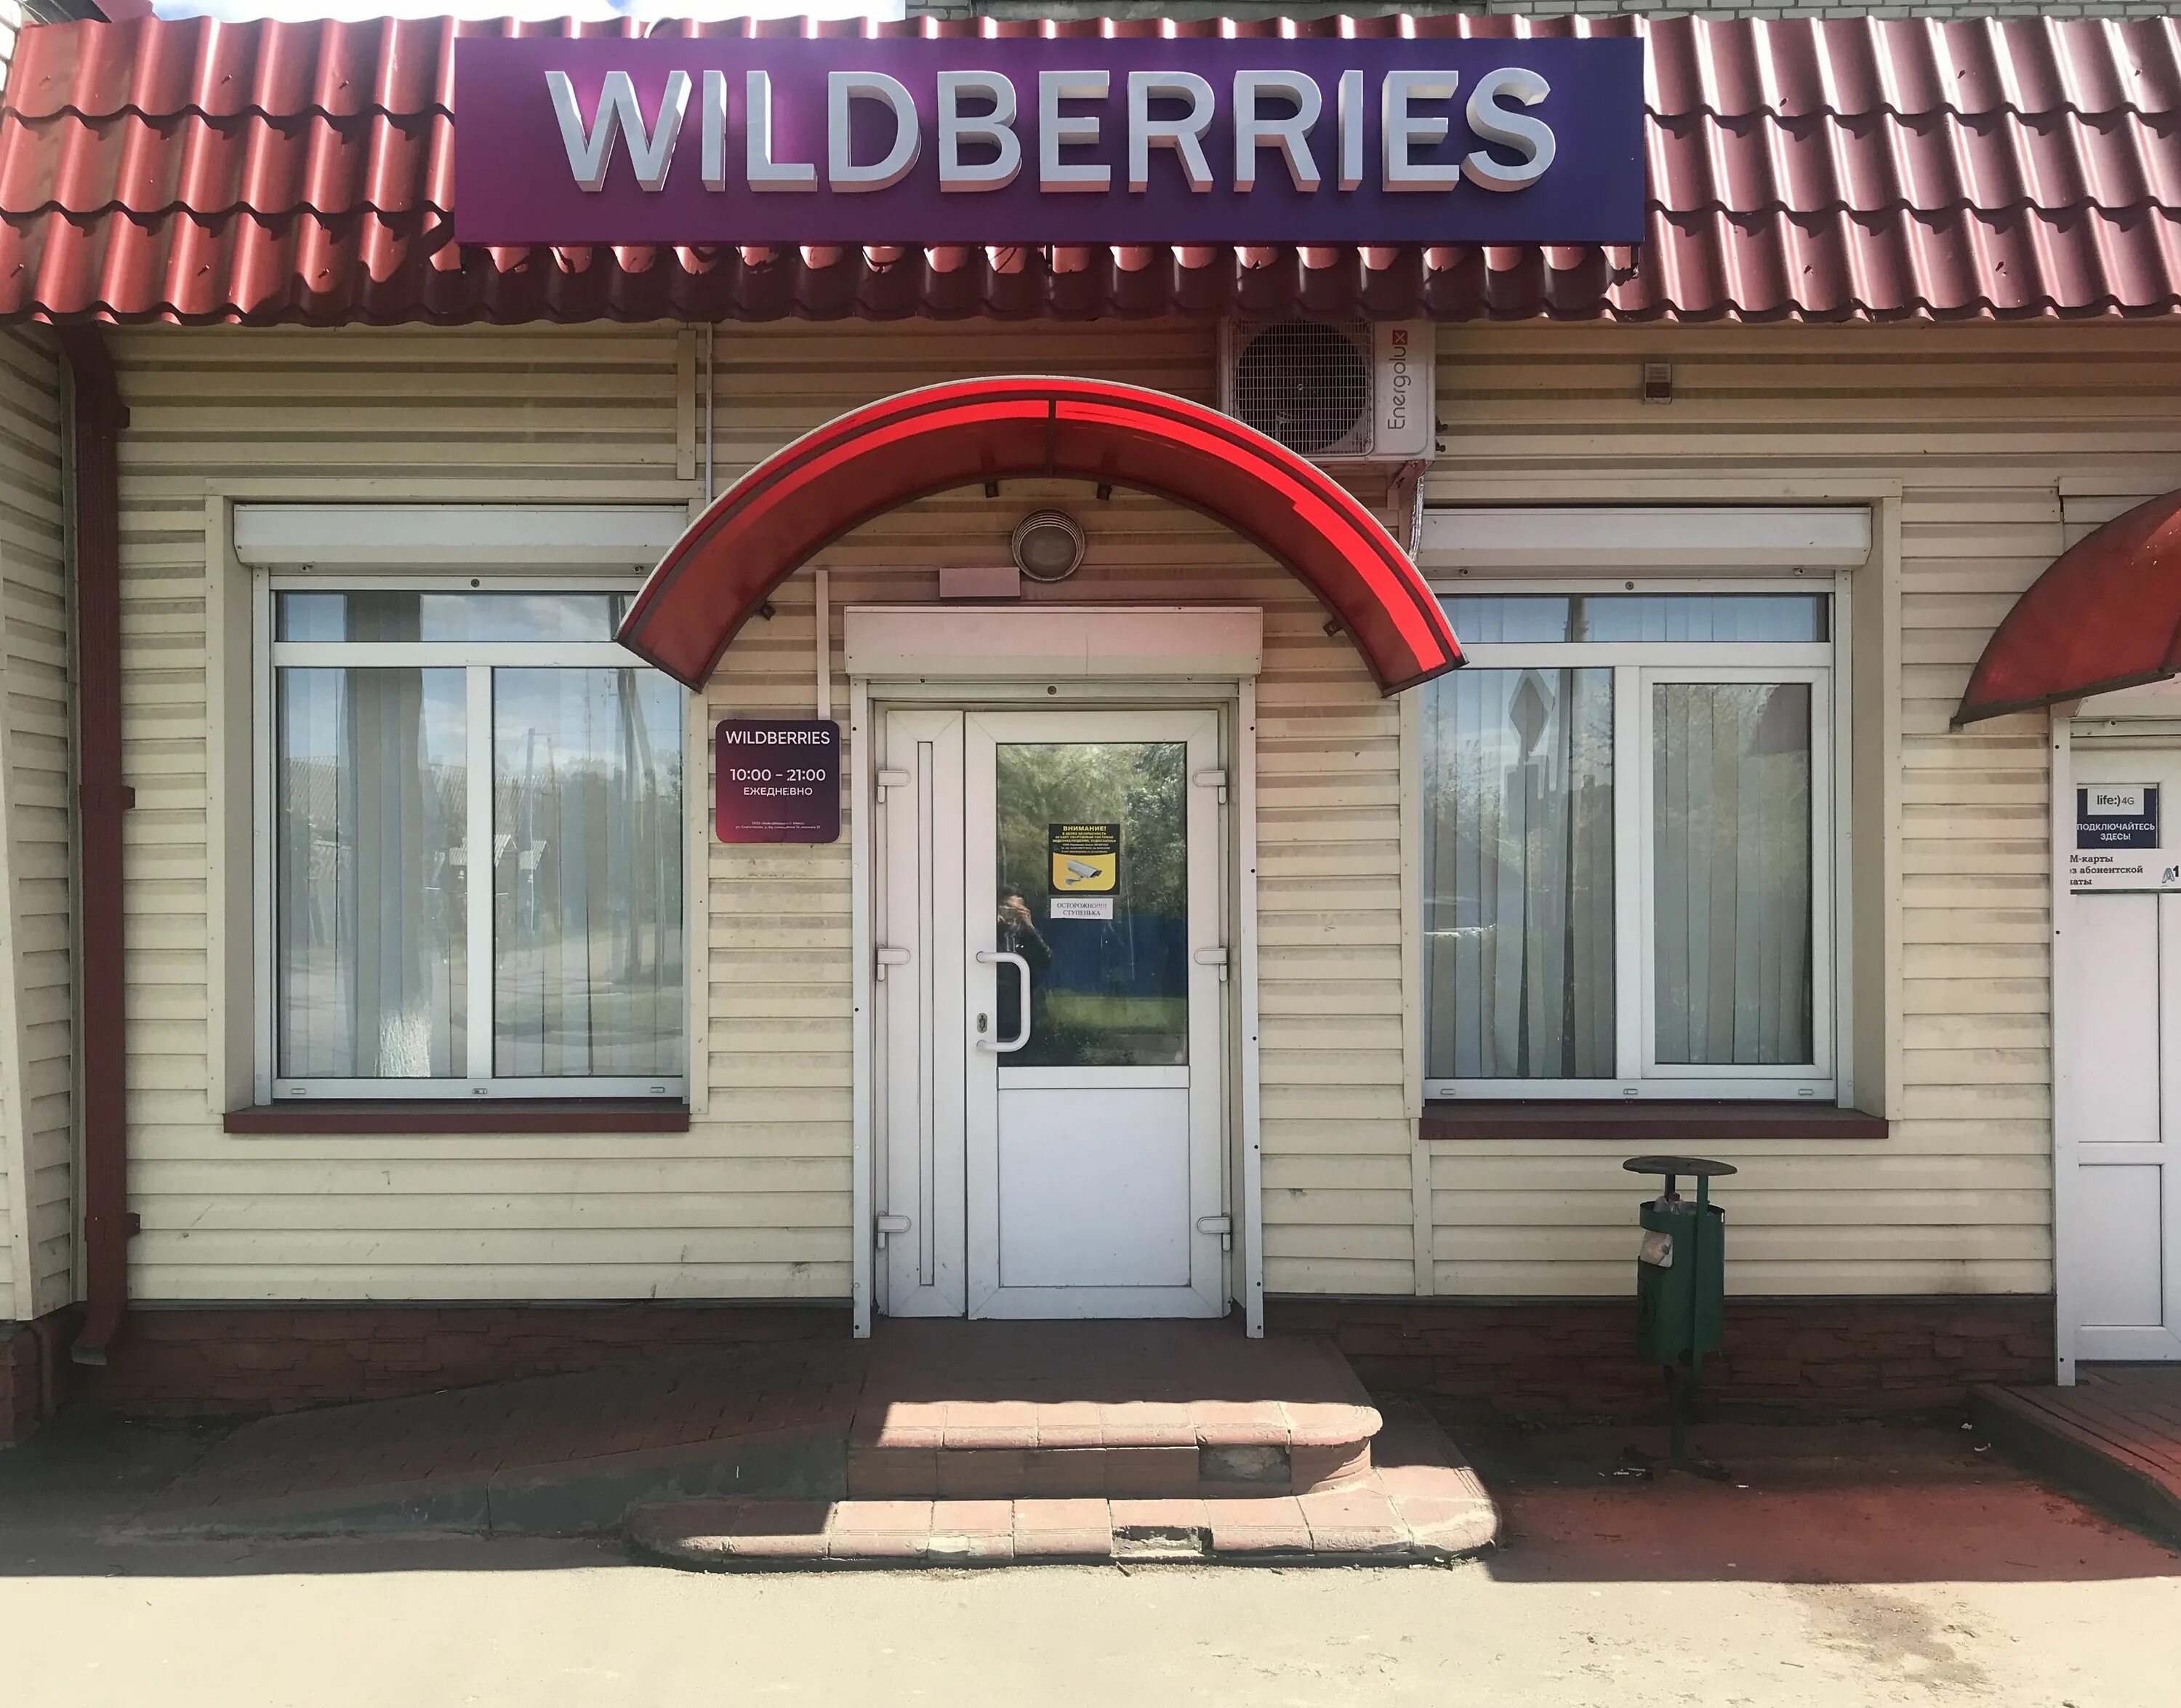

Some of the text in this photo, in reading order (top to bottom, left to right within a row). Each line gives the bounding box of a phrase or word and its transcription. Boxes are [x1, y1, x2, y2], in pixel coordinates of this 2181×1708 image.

[545, 67, 1557, 193] WILDBERRIES
[1387, 329, 1412, 430] Energolux
[726, 731, 830, 745] WILDBERRIES
[730, 769, 771, 781] 10:00
[787, 769, 826, 781] 21:00
[744, 787, 813, 796] ЕЖЕДНЕВНО
[2097, 795, 2121, 806] life:)
[2077, 822, 2155, 831] ПОДКЛЮЧАЙТЕСЬ
[2079, 865, 2143, 874] абонентской
